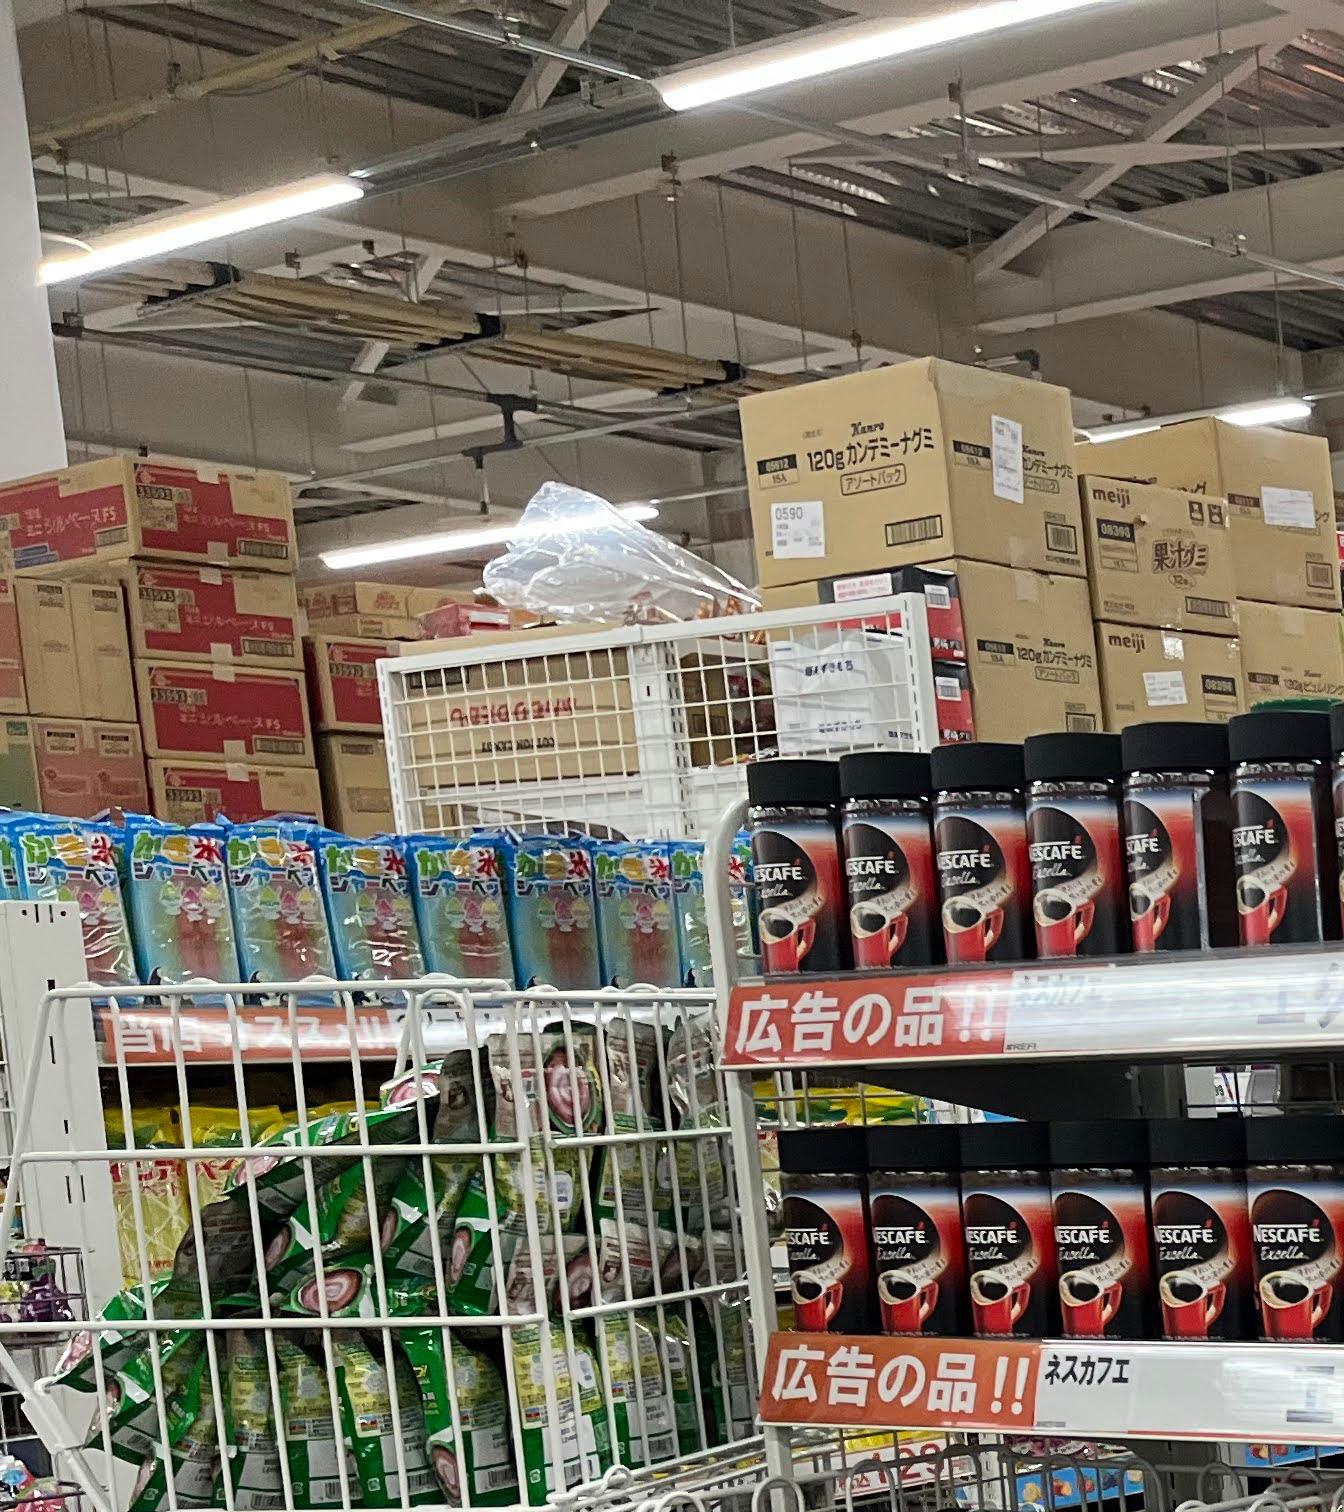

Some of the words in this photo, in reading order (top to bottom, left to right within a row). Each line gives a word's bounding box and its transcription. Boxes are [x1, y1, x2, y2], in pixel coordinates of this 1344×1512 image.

[1092, 486, 1131, 509] meiji
[1153, 540, 1208, 572] 果汁グミ
[1108, 632, 1146, 654] meiji
[1043, 1352, 1132, 1387] ネスカフェ
